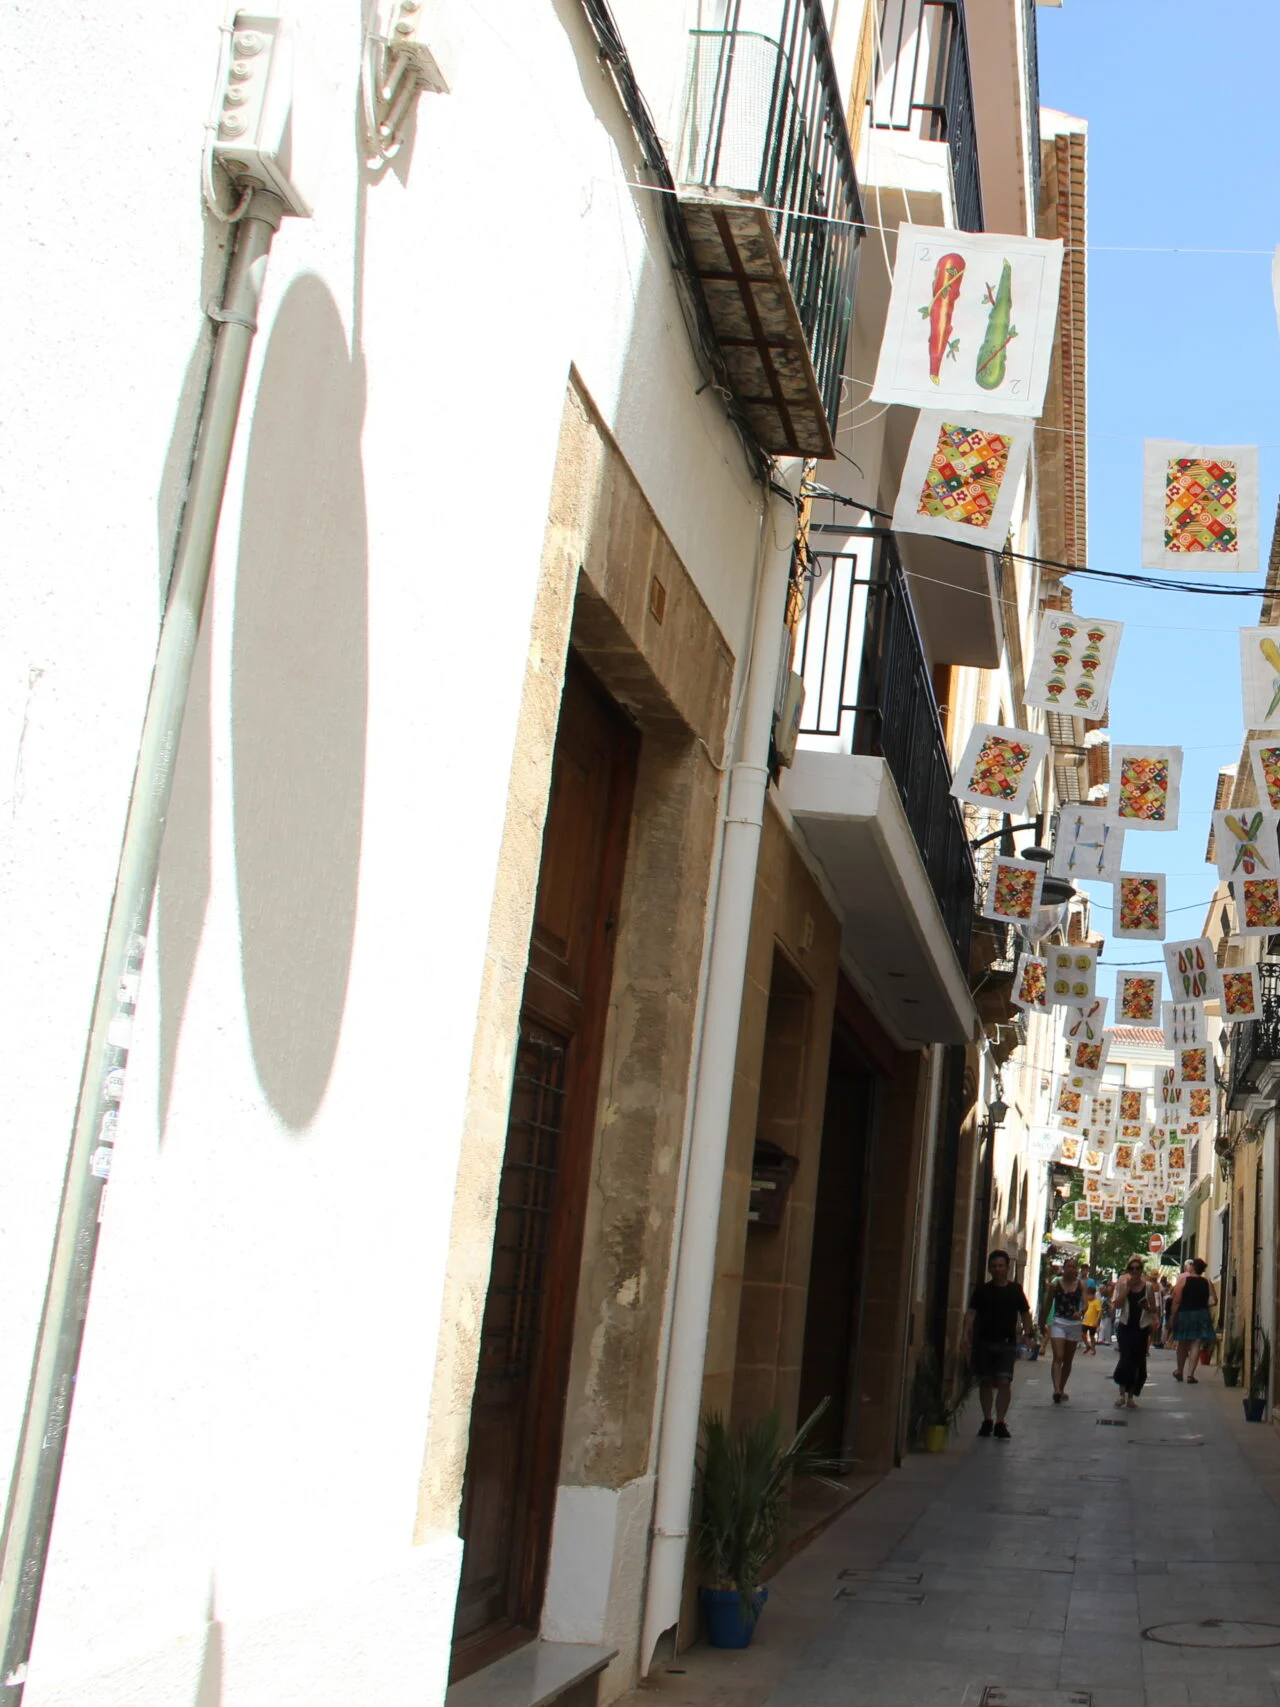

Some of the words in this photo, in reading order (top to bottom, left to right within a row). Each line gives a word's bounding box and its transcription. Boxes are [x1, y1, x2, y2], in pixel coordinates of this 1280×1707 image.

[920, 247, 931, 262] 2
[1010, 379, 1022, 394] 2
[1050, 618, 1058, 630] 6
